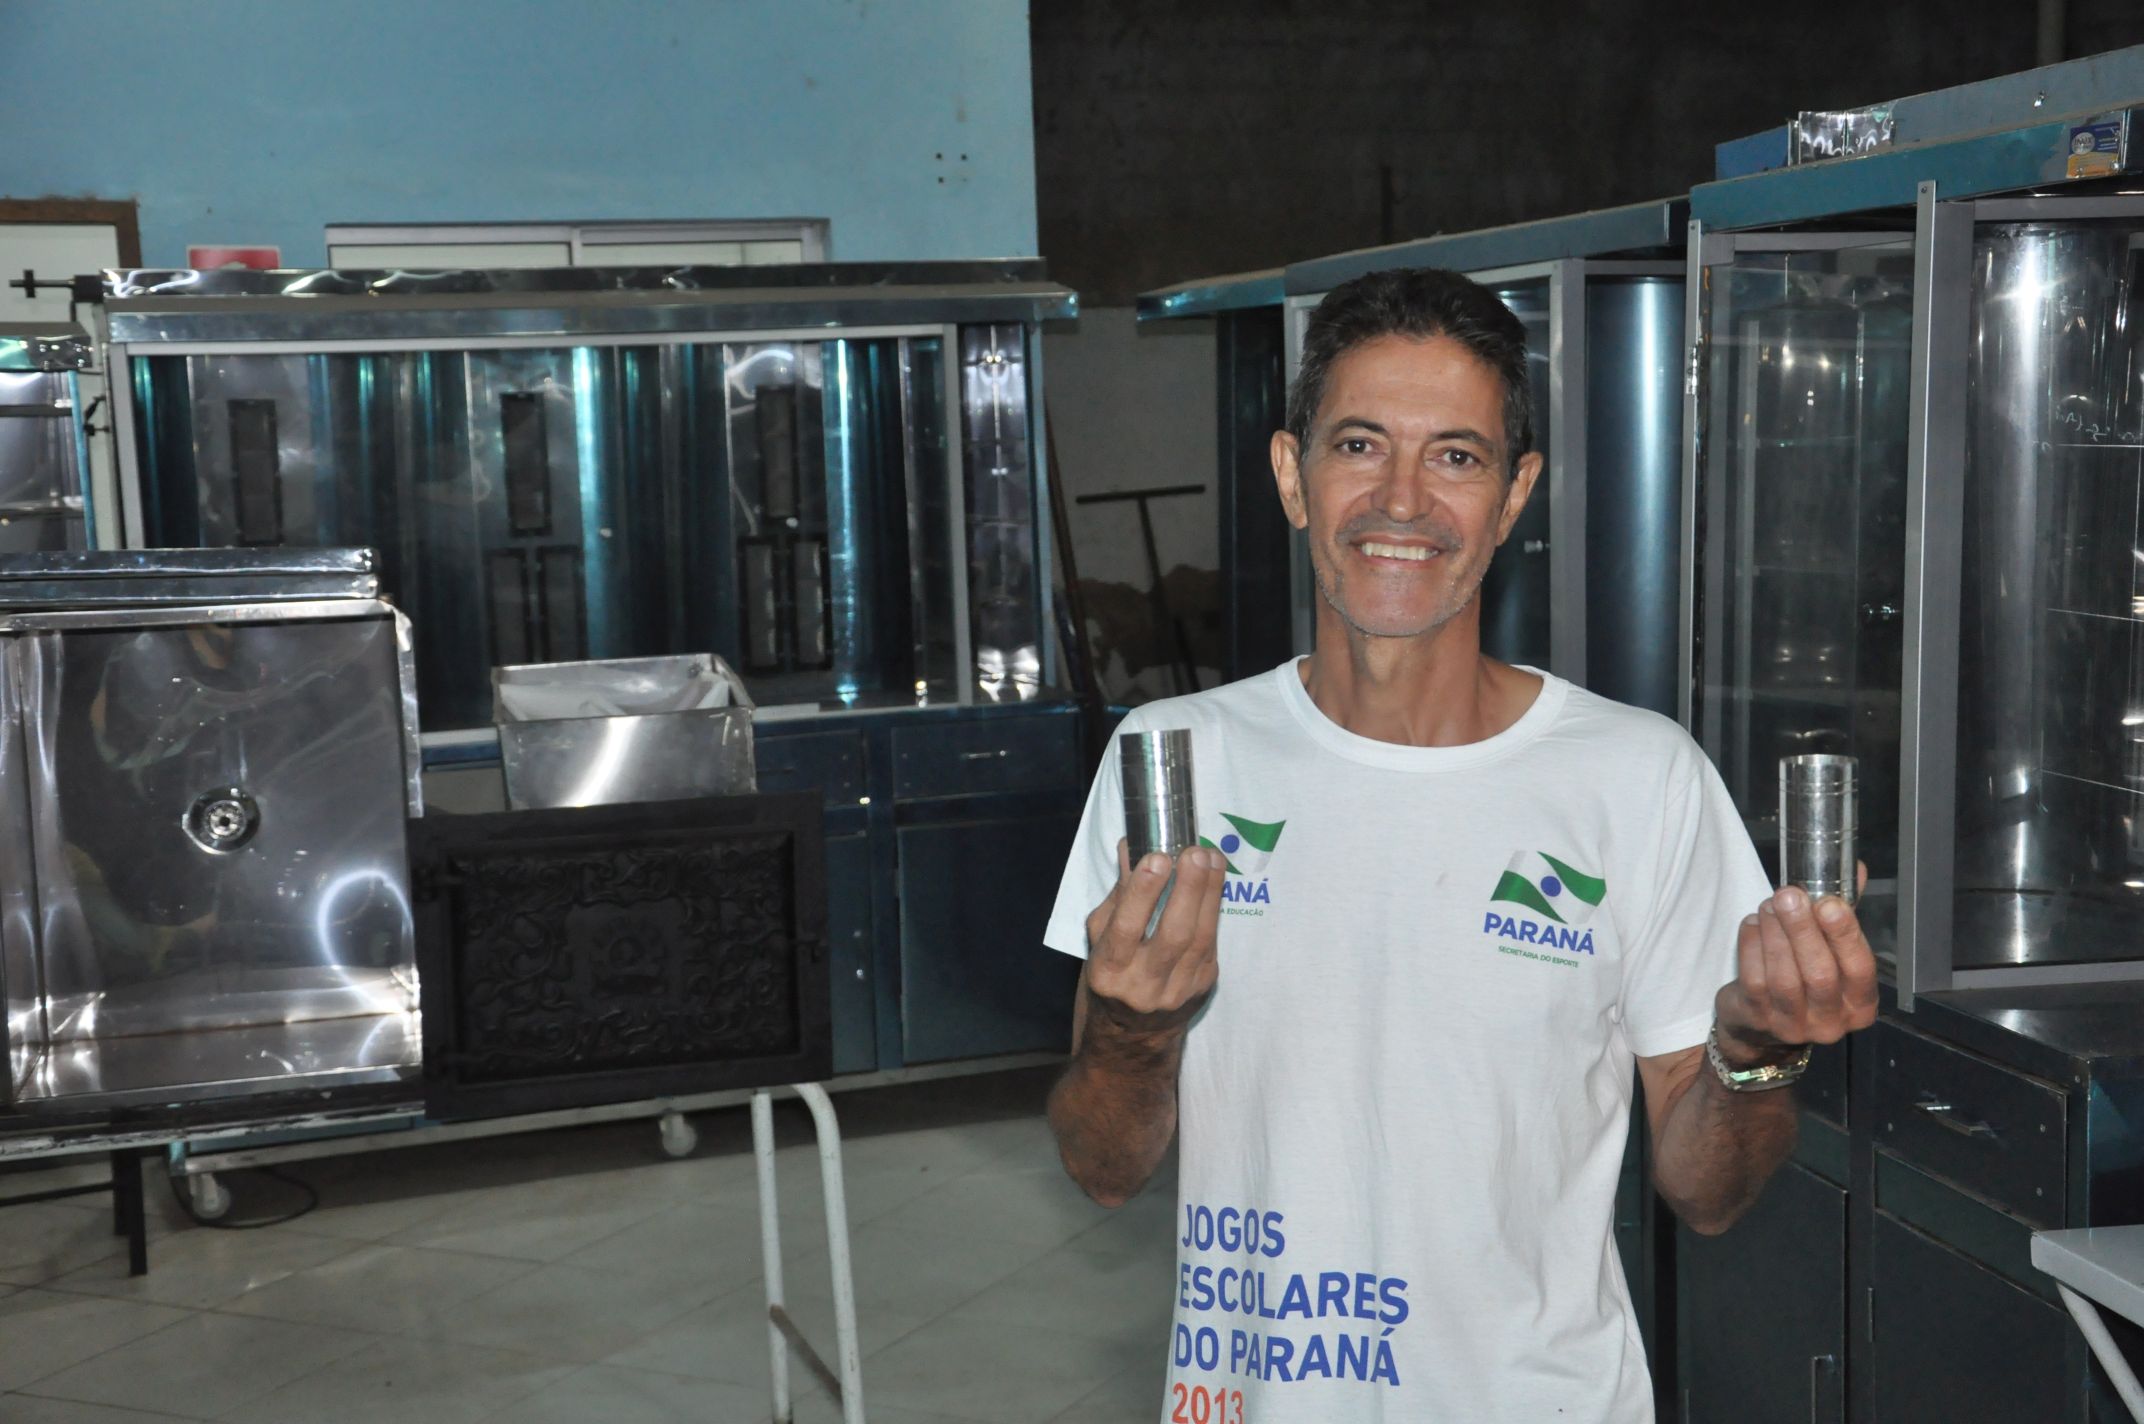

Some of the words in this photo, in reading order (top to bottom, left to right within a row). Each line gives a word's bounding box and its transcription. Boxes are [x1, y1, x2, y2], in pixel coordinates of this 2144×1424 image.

[1221, 878, 1270, 904] ANÁ
[1483, 912, 1595, 955] PARANÁ
[1498, 945, 1539, 960] SECRETARIA
[1540, 954, 1551, 963] DO
[1552, 957, 1579, 968] ESPORTE
[1182, 1204, 1285, 1258] JOGOS
[1179, 1262, 1409, 1325] ESCOLARES
[1174, 1323, 1220, 1371] DO
[1230, 1327, 1400, 1386] PARANÁ
[1171, 1382, 1243, 1424] 2013
